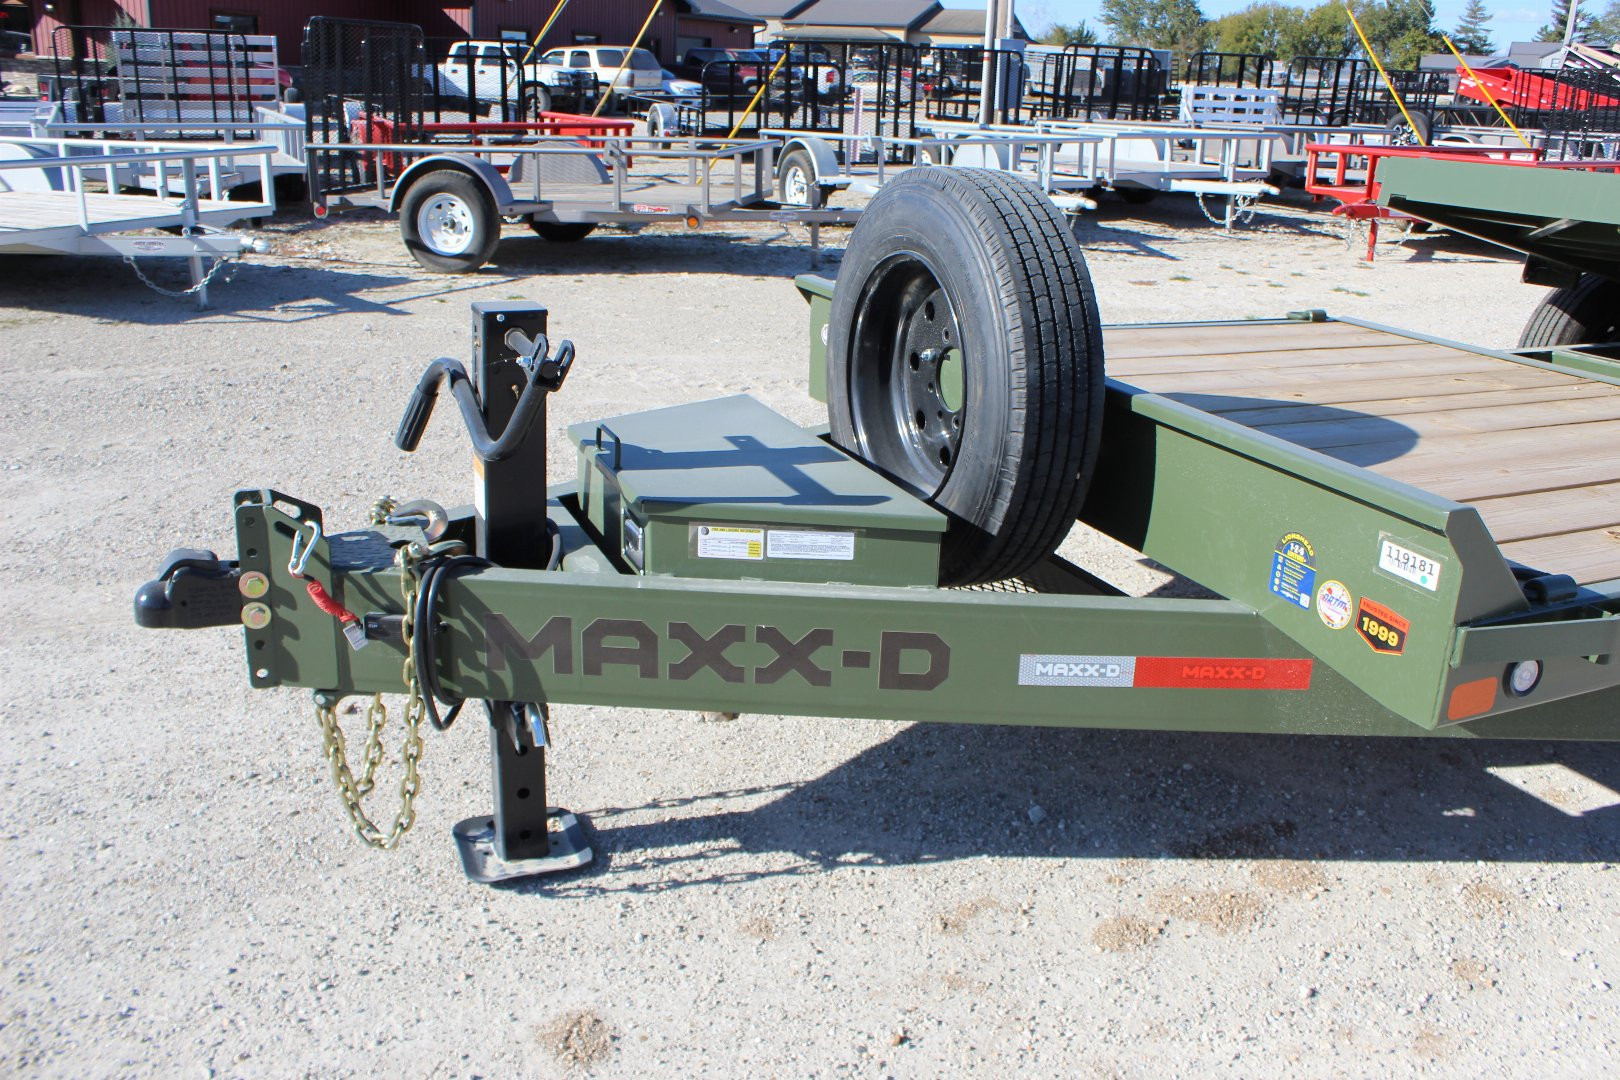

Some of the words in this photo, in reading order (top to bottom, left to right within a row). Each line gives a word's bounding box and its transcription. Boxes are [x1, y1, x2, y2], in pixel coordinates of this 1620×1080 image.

[1386, 545, 1434, 577] 119181
[1362, 601, 1389, 620] TRUSTED
[1389, 615, 1407, 629] SINCE
[1362, 616, 1399, 647] 1999
[485, 612, 951, 692] MAXX-D
[1035, 662, 1121, 678] MAXX-D
[1181, 665, 1266, 680] MAXX-D
